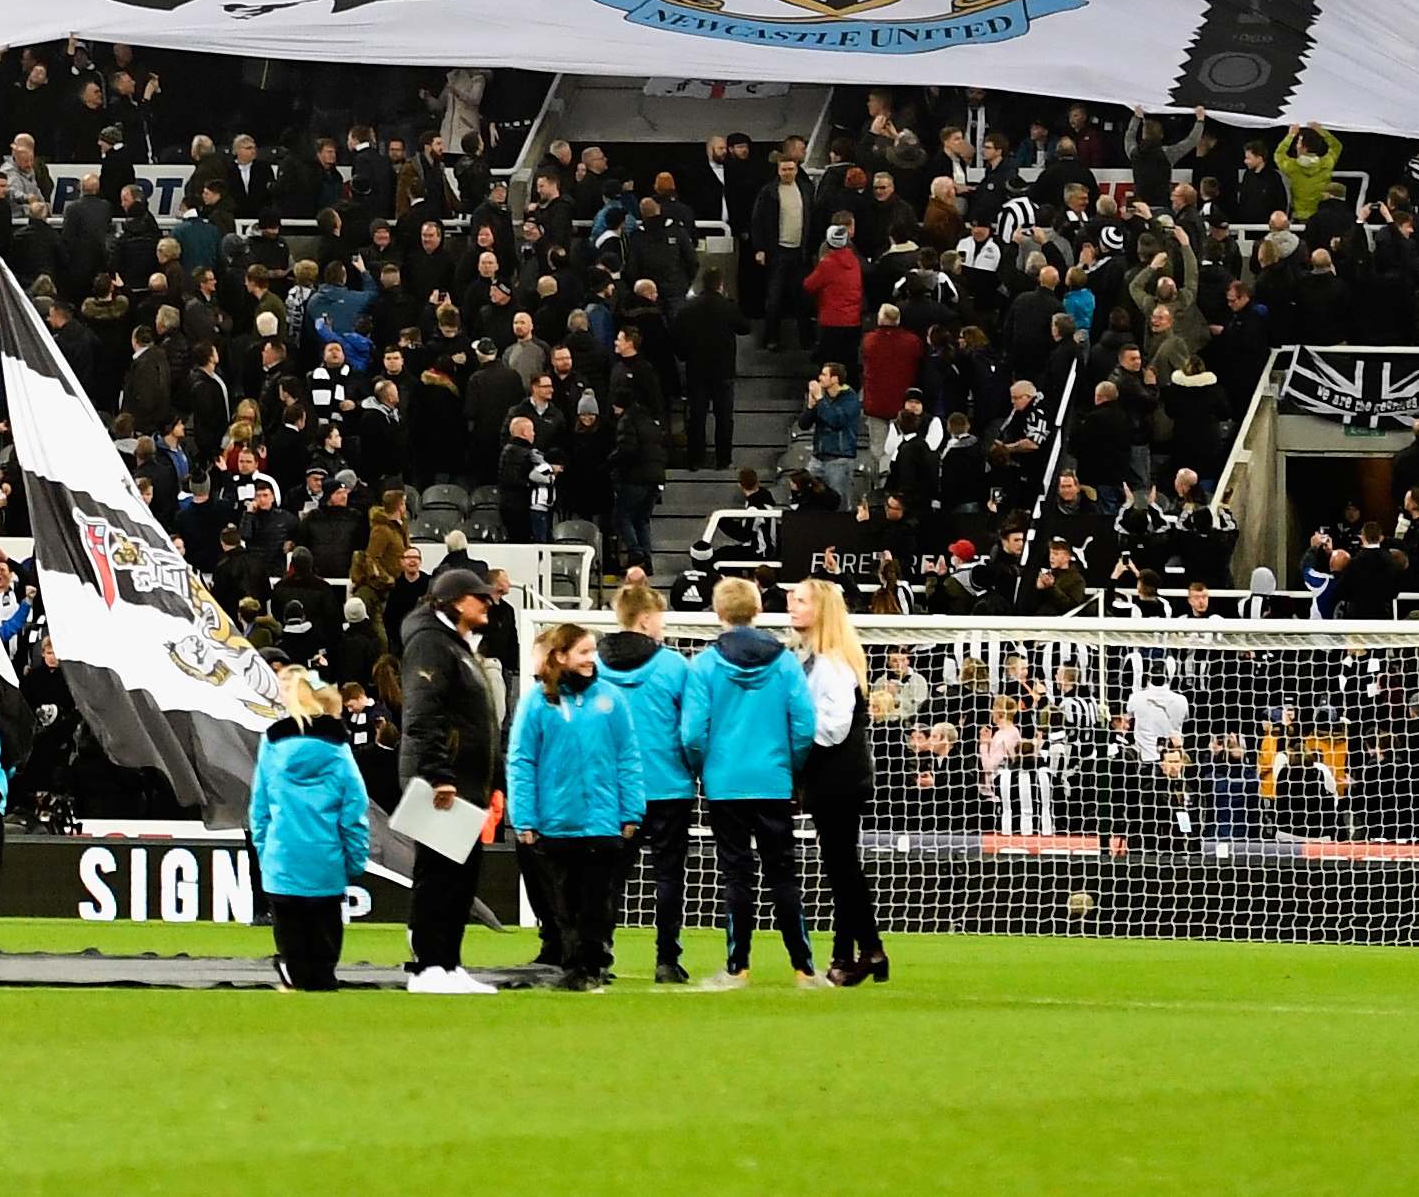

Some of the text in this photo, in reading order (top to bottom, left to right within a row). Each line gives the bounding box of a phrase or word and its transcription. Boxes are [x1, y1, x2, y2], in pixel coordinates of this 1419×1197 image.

[642, 8, 1013, 48] NEWCASTLE UNITED
[78, 847, 254, 924] SIGN
